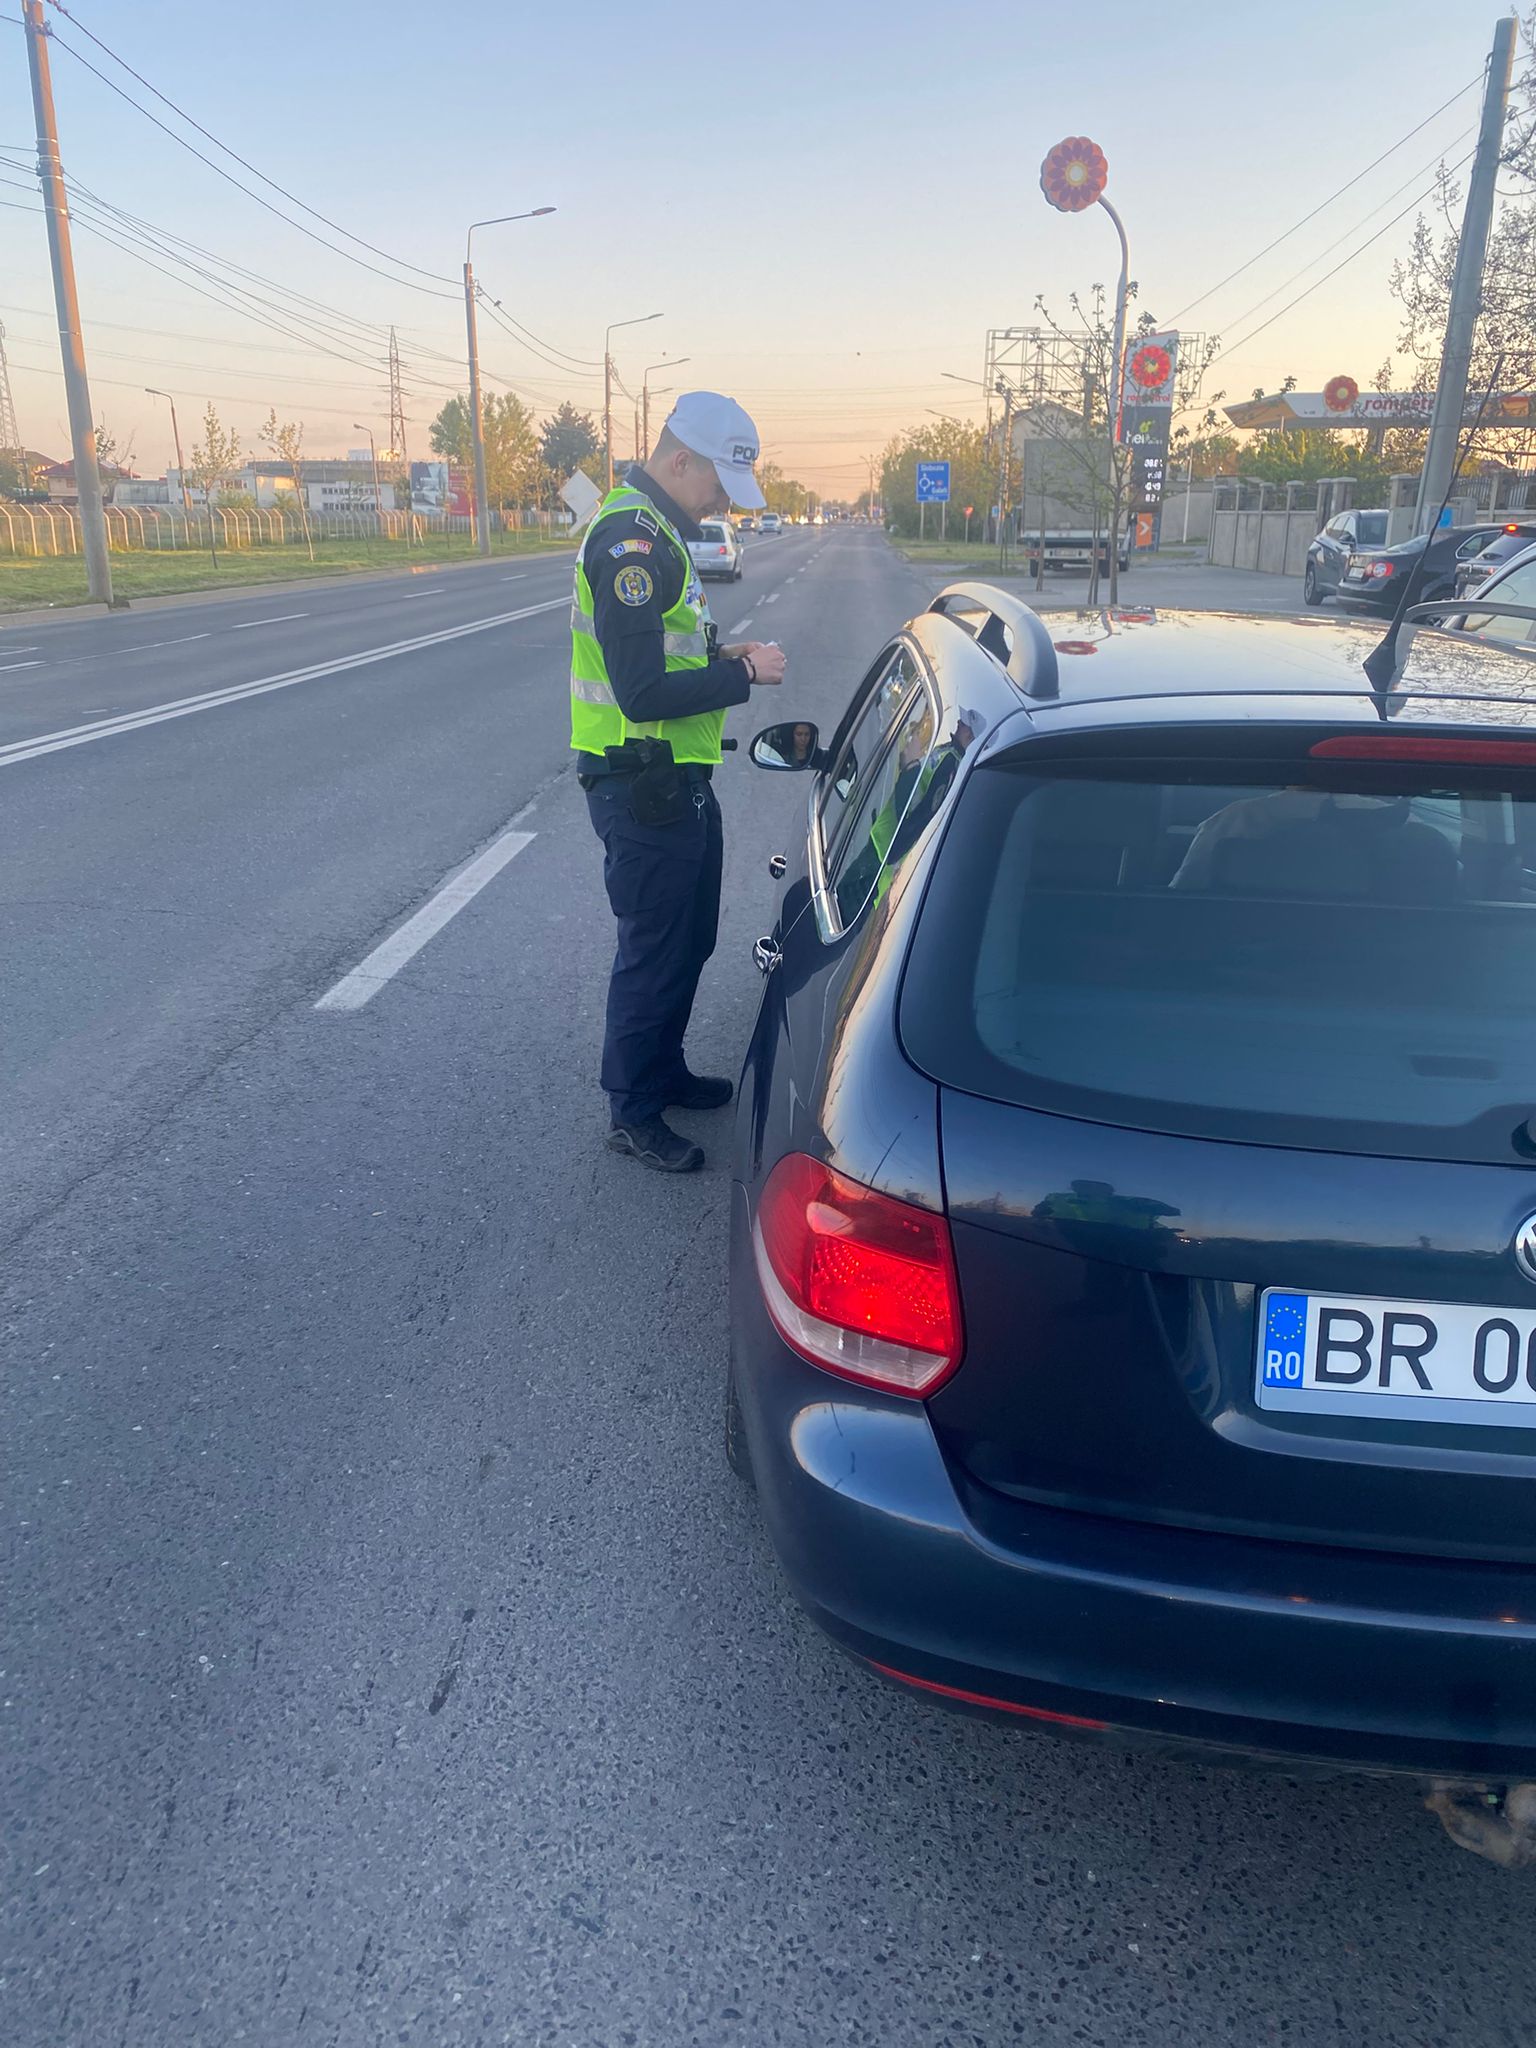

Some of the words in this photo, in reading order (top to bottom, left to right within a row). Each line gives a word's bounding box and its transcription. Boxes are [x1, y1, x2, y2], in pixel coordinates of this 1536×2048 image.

[1266, 1350, 1301, 1380] RO
[1315, 1307, 1438, 1391] BR
[1473, 1317, 1536, 1396] 0
